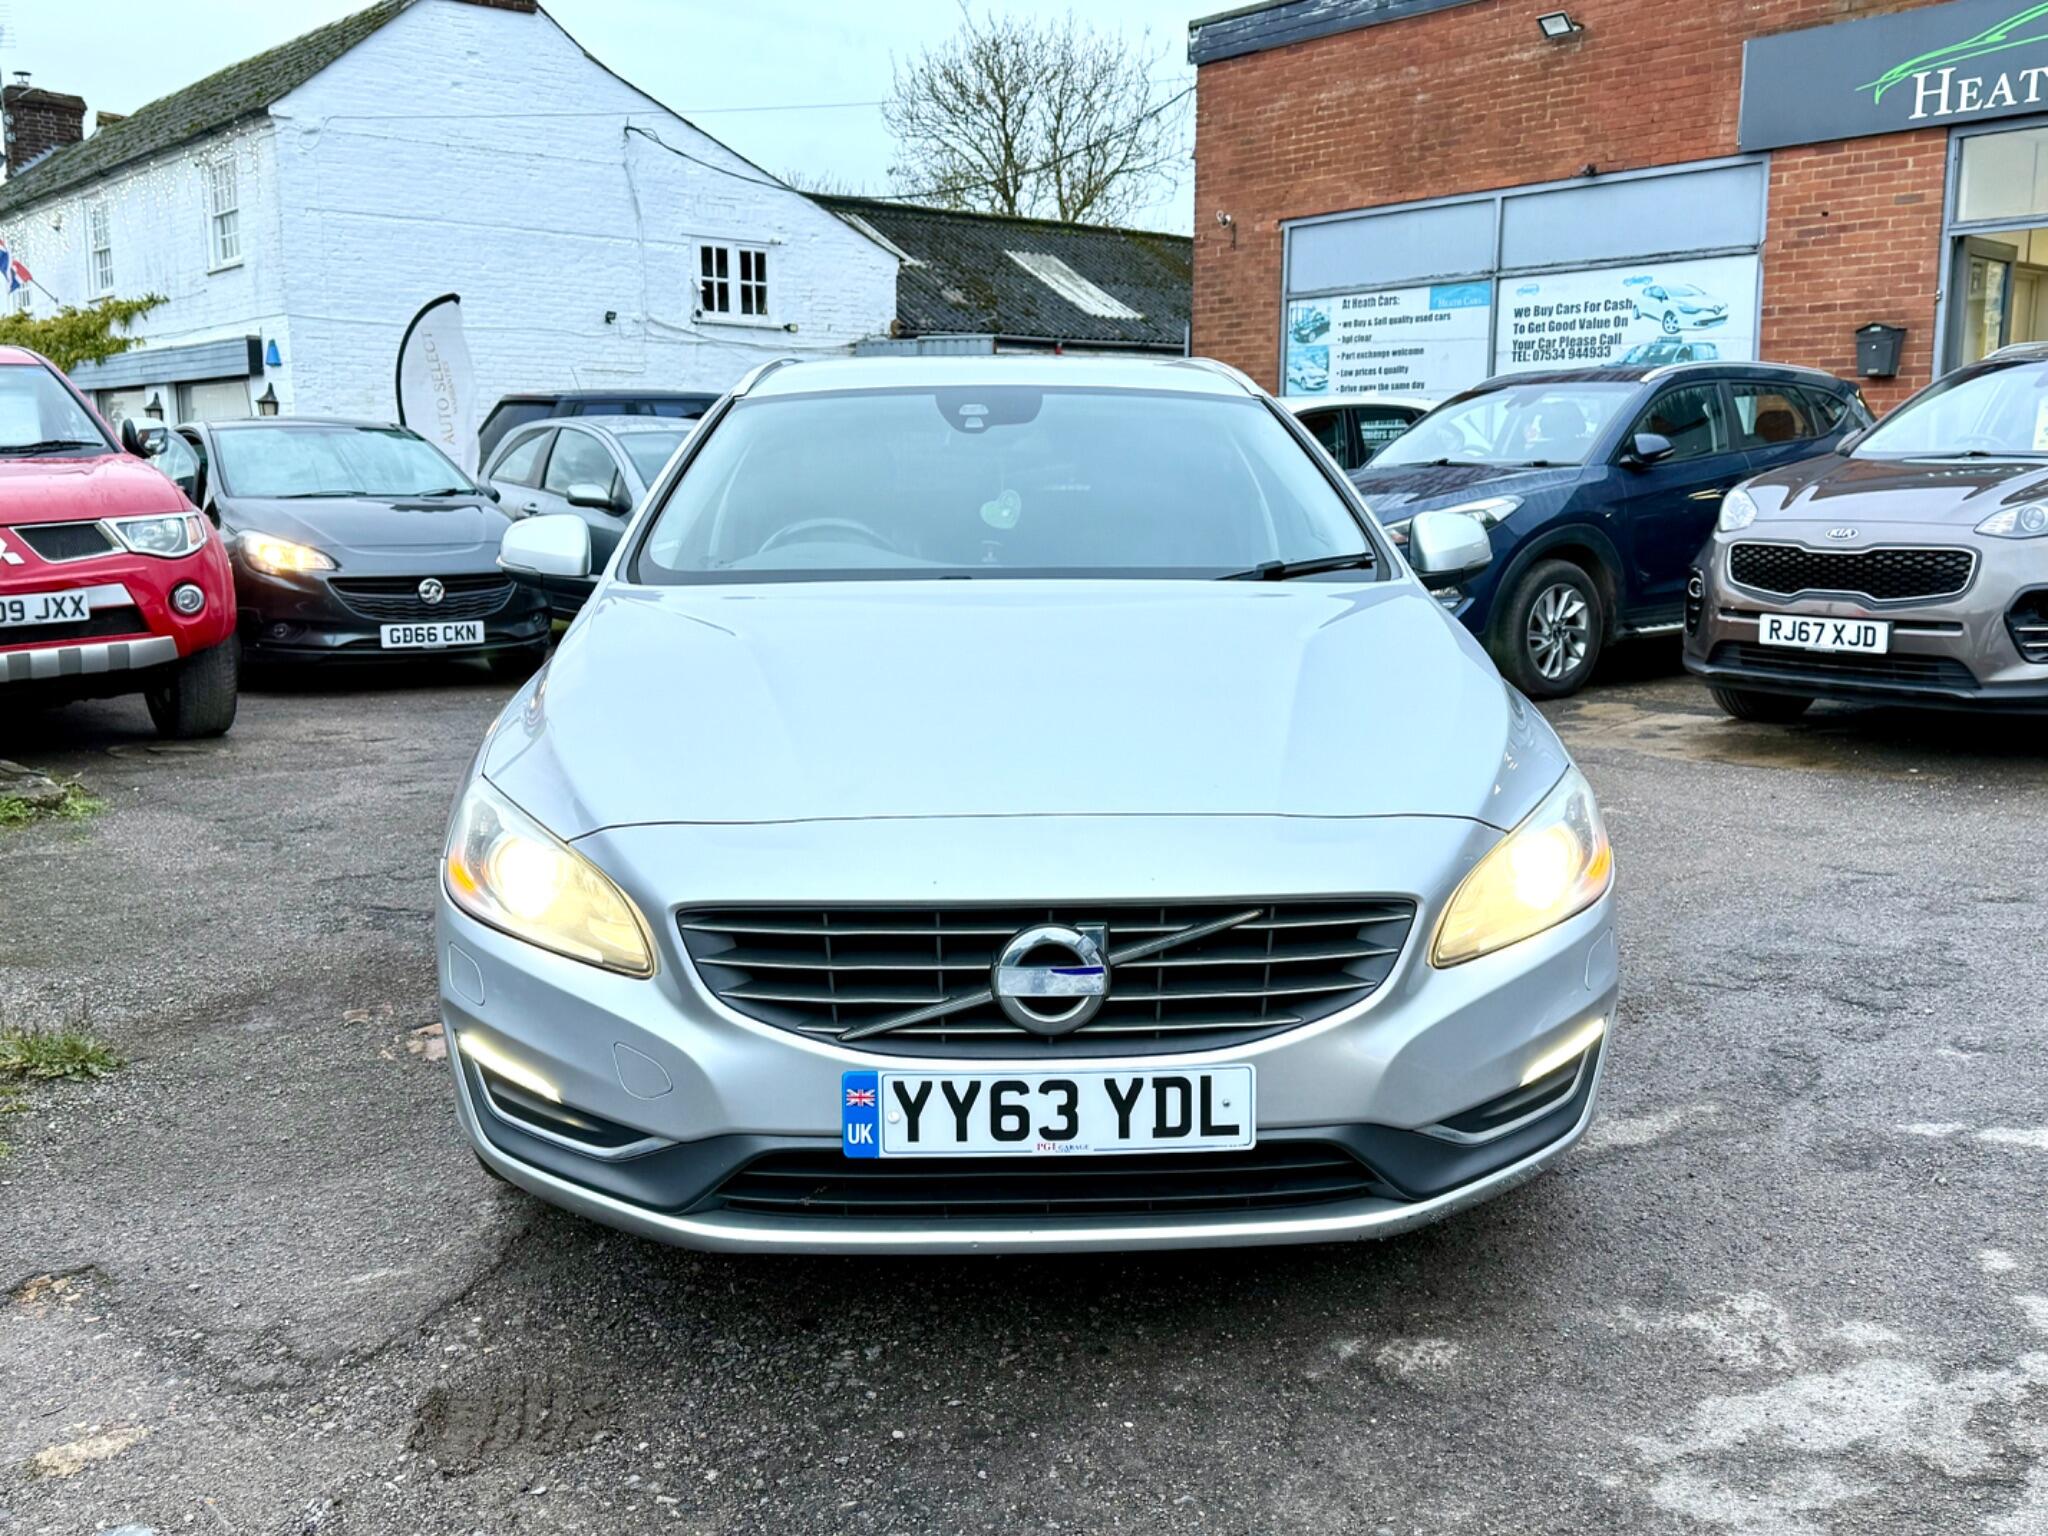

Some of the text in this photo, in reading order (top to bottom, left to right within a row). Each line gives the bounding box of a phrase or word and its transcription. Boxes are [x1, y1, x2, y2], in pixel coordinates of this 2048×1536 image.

[1342, 298, 1350, 309] At
[1352, 297, 1376, 308] Heath
[1514, 306, 1531, 318] we
[1533, 304, 1554, 318] Buy
[1556, 303, 1582, 316] Cars
[1584, 300, 1602, 314] For
[1354, 319, 1366, 328] Buy
[1374, 316, 1387, 326] Sell
[1389, 314, 1413, 326] quality
[1415, 314, 1433, 323] used
[1434, 312, 1451, 321] cars
[1513, 315, 1629, 335] To Get Good Value On
[1354, 334, 1372, 343] clear
[1512, 332, 1623, 351] Your Car Please Call
[1341, 347, 1424, 360] Part exchange welcome
[1512, 345, 1612, 363] TEL: 07534 944933
[1341, 369, 1353, 378] Low
[1355, 367, 1377, 377] prices
[1384, 365, 1409, 376] quality
[421, 330, 456, 445] AUTO SELECT
[1341, 384, 1357, 393] Drive
[1378, 382, 1389, 391] the
[1391, 382, 1410, 390] same
[1412, 380, 1425, 390] day
[35, 595, 86, 619] JXX
[389, 624, 477, 644] GD66 CKN
[1769, 618, 1877, 648] RJ67 XJD
[893, 1075, 1240, 1142] YY63 YDL
[848, 1123, 874, 1144] UK
